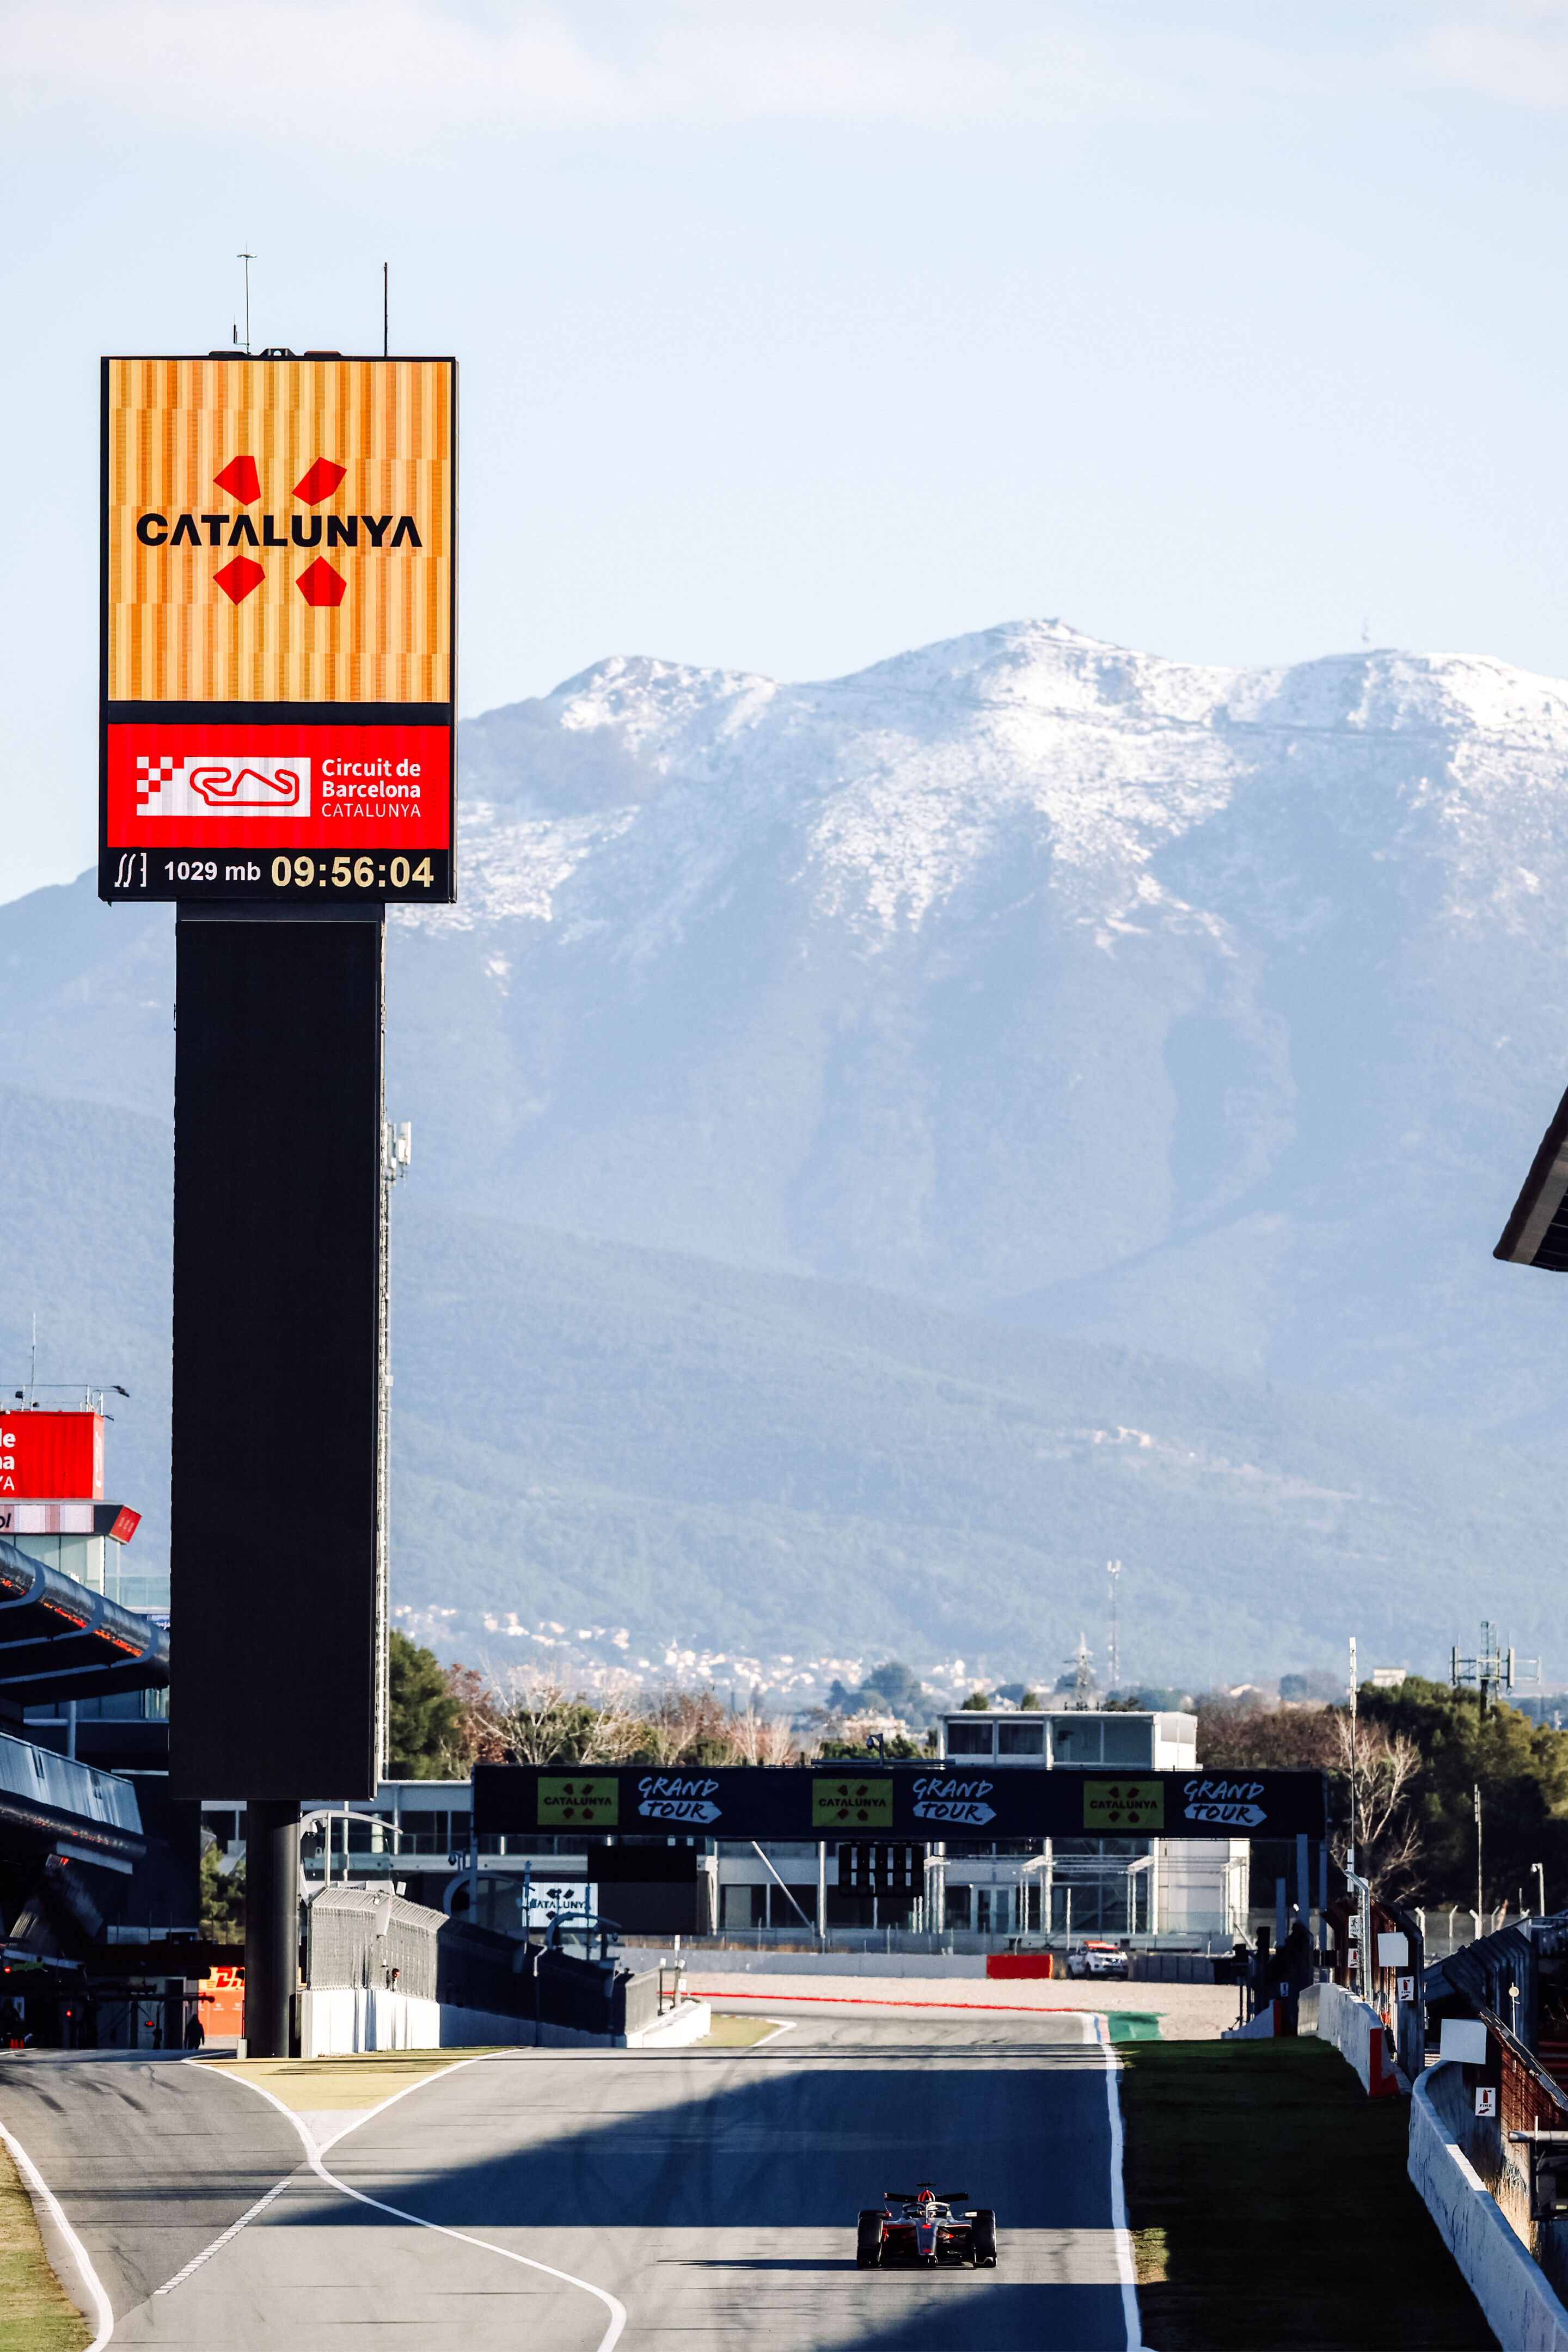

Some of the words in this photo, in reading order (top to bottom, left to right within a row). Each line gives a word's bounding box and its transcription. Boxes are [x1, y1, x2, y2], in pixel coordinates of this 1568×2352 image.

[137, 513, 423, 548] CATALUNYA
[322, 758, 393, 777] Circuit
[396, 758, 421, 777] de
[322, 781, 421, 798] Barcelona
[322, 804, 421, 818] CATALUNYA
[164, 861, 218, 881] 1029
[225, 862, 261, 881] mb
[271, 856, 434, 889] 09:56:04
[638, 1777, 719, 1798] GRAND
[913, 1778, 994, 1799] GRAND
[1184, 1780, 1264, 1802] GRAND
[544, 1797, 612, 1806] CATALUNYA
[647, 1801, 708, 1819] TOUR
[818, 1798, 887, 1808] CATALUNYA
[1089, 1800, 1158, 1809] CATALUNYA
[922, 1803, 983, 1821] TOUR
[1193, 1804, 1254, 1822] TOUR
